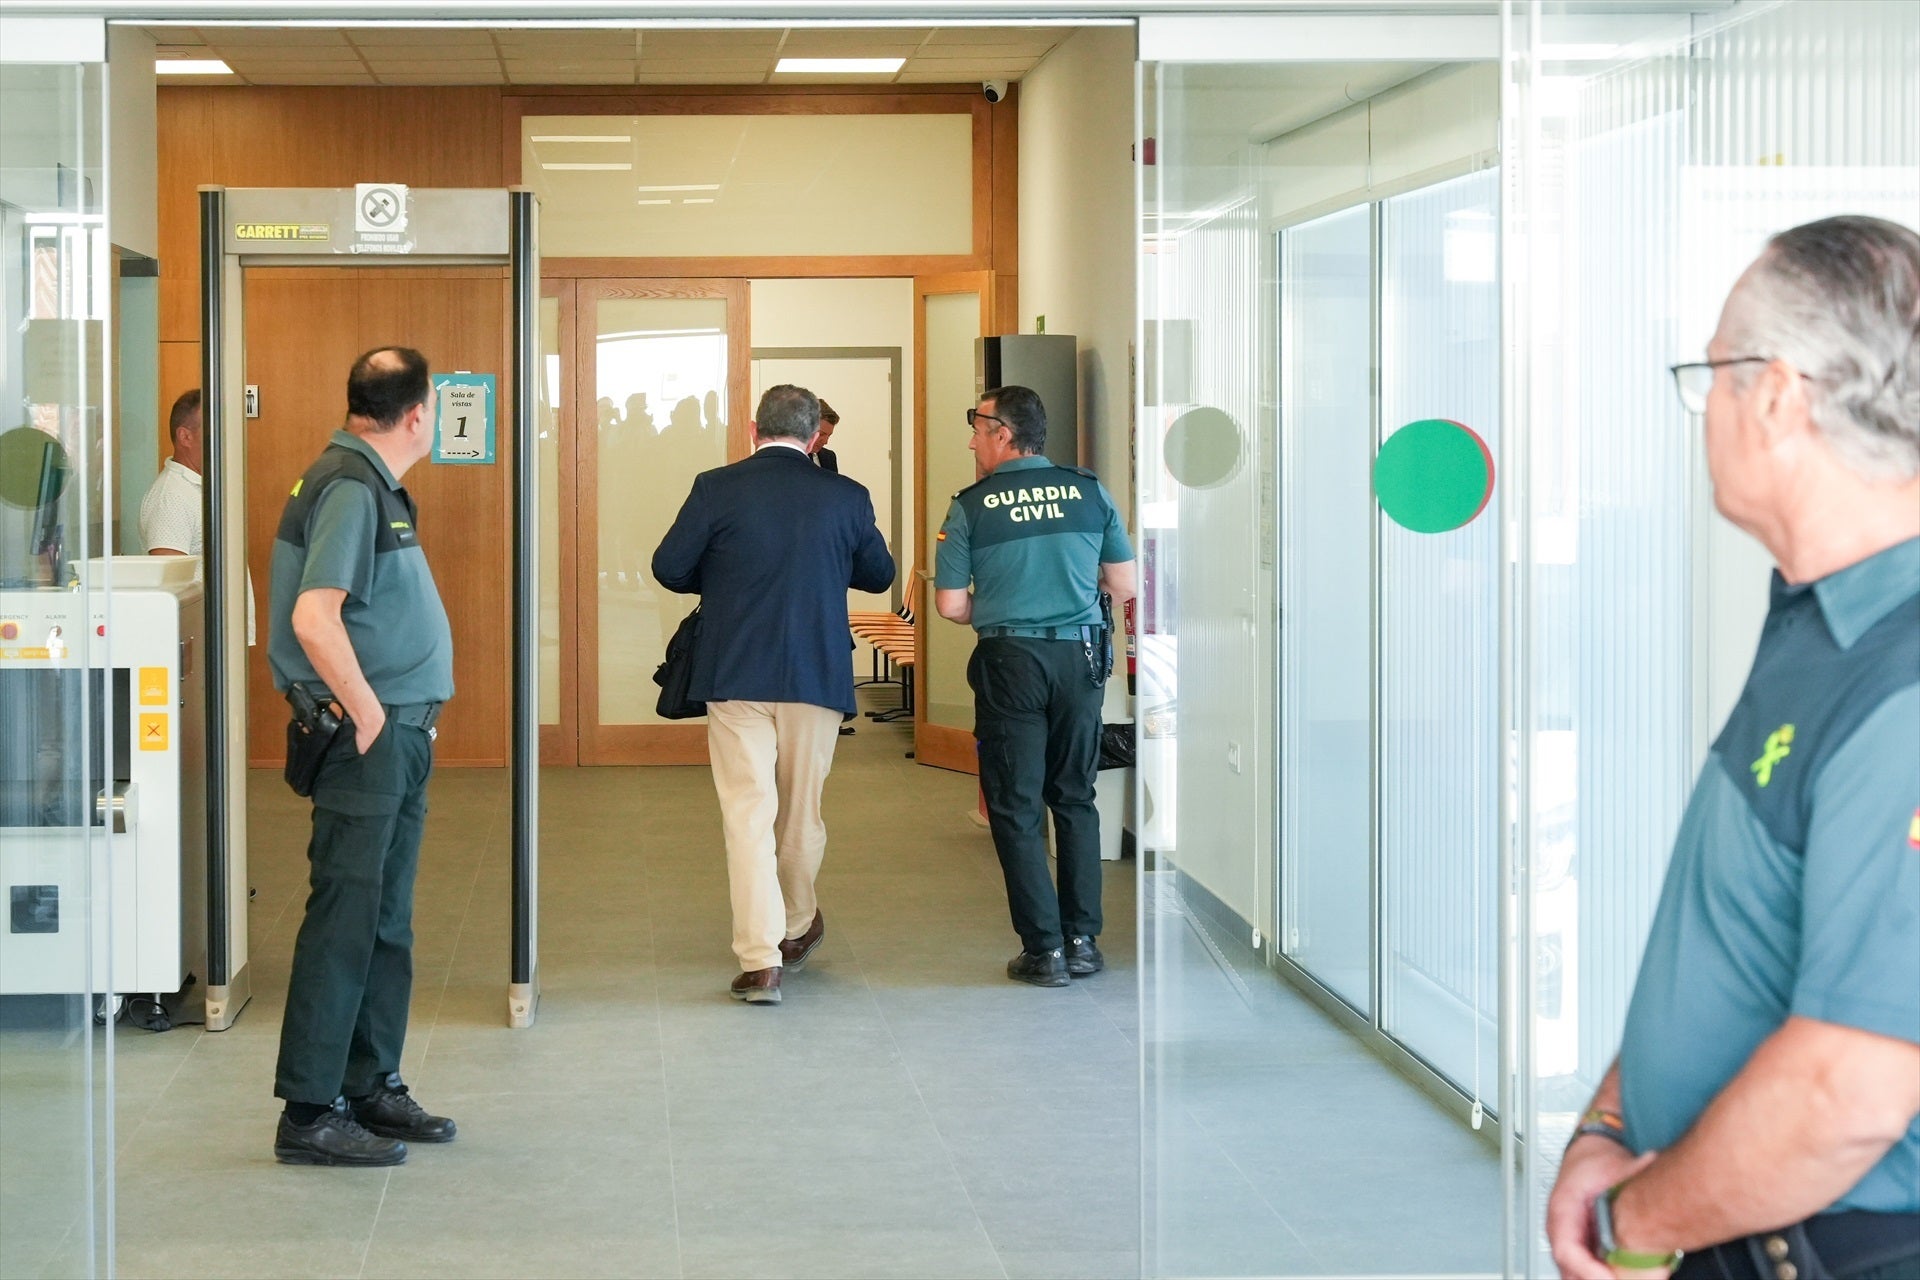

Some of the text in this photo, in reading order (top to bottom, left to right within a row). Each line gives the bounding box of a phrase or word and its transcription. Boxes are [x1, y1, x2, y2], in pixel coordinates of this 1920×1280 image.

[236, 225, 299, 238] GARRETT
[454, 416, 467, 437] 1
[983, 485, 1082, 508] GUARDIA
[1010, 503, 1064, 522] CIVIL
